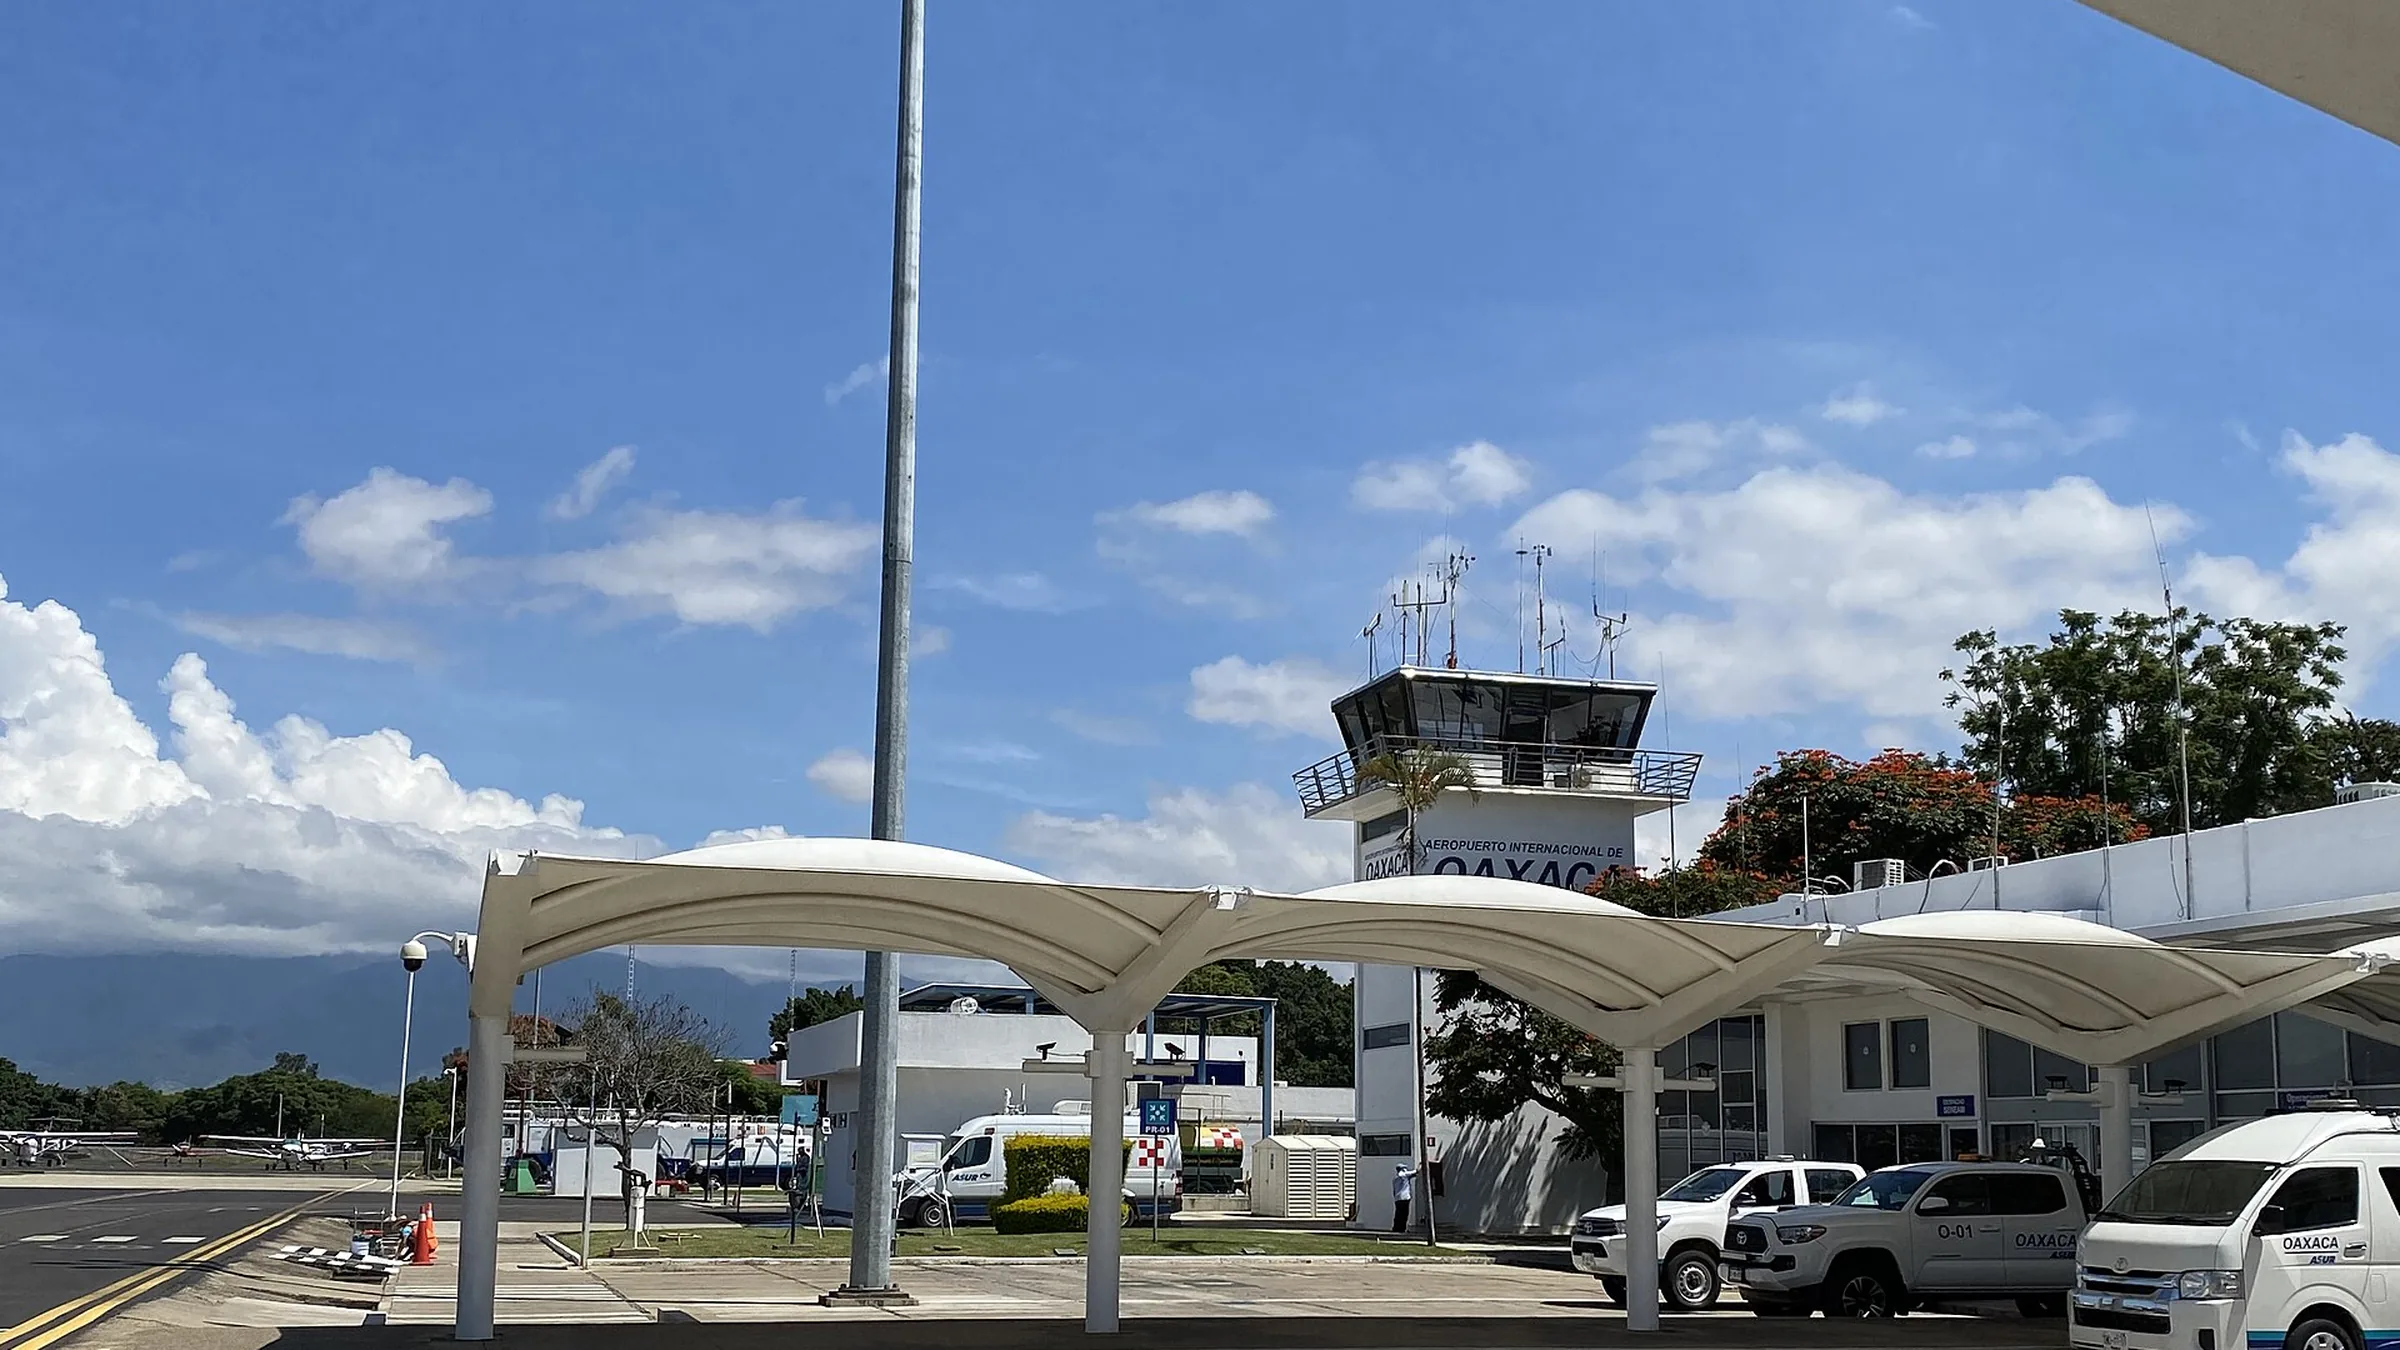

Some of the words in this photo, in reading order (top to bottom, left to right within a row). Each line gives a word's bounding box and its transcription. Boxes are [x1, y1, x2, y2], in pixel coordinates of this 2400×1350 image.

[1425, 839, 1507, 852] AEROPUERTO
[1508, 841, 1604, 857] INTERNACIONAL
[1606, 847, 1624, 858] DE
[1365, 851, 1409, 881] OAXACA
[1145, 1125, 1170, 1134] PR-01
[951, 1173, 979, 1182] ASUR
[2014, 1233, 2077, 1248] OAXACA
[2282, 1236, 2339, 1250] OAXACA
[2309, 1255, 2337, 1265] ASUR
